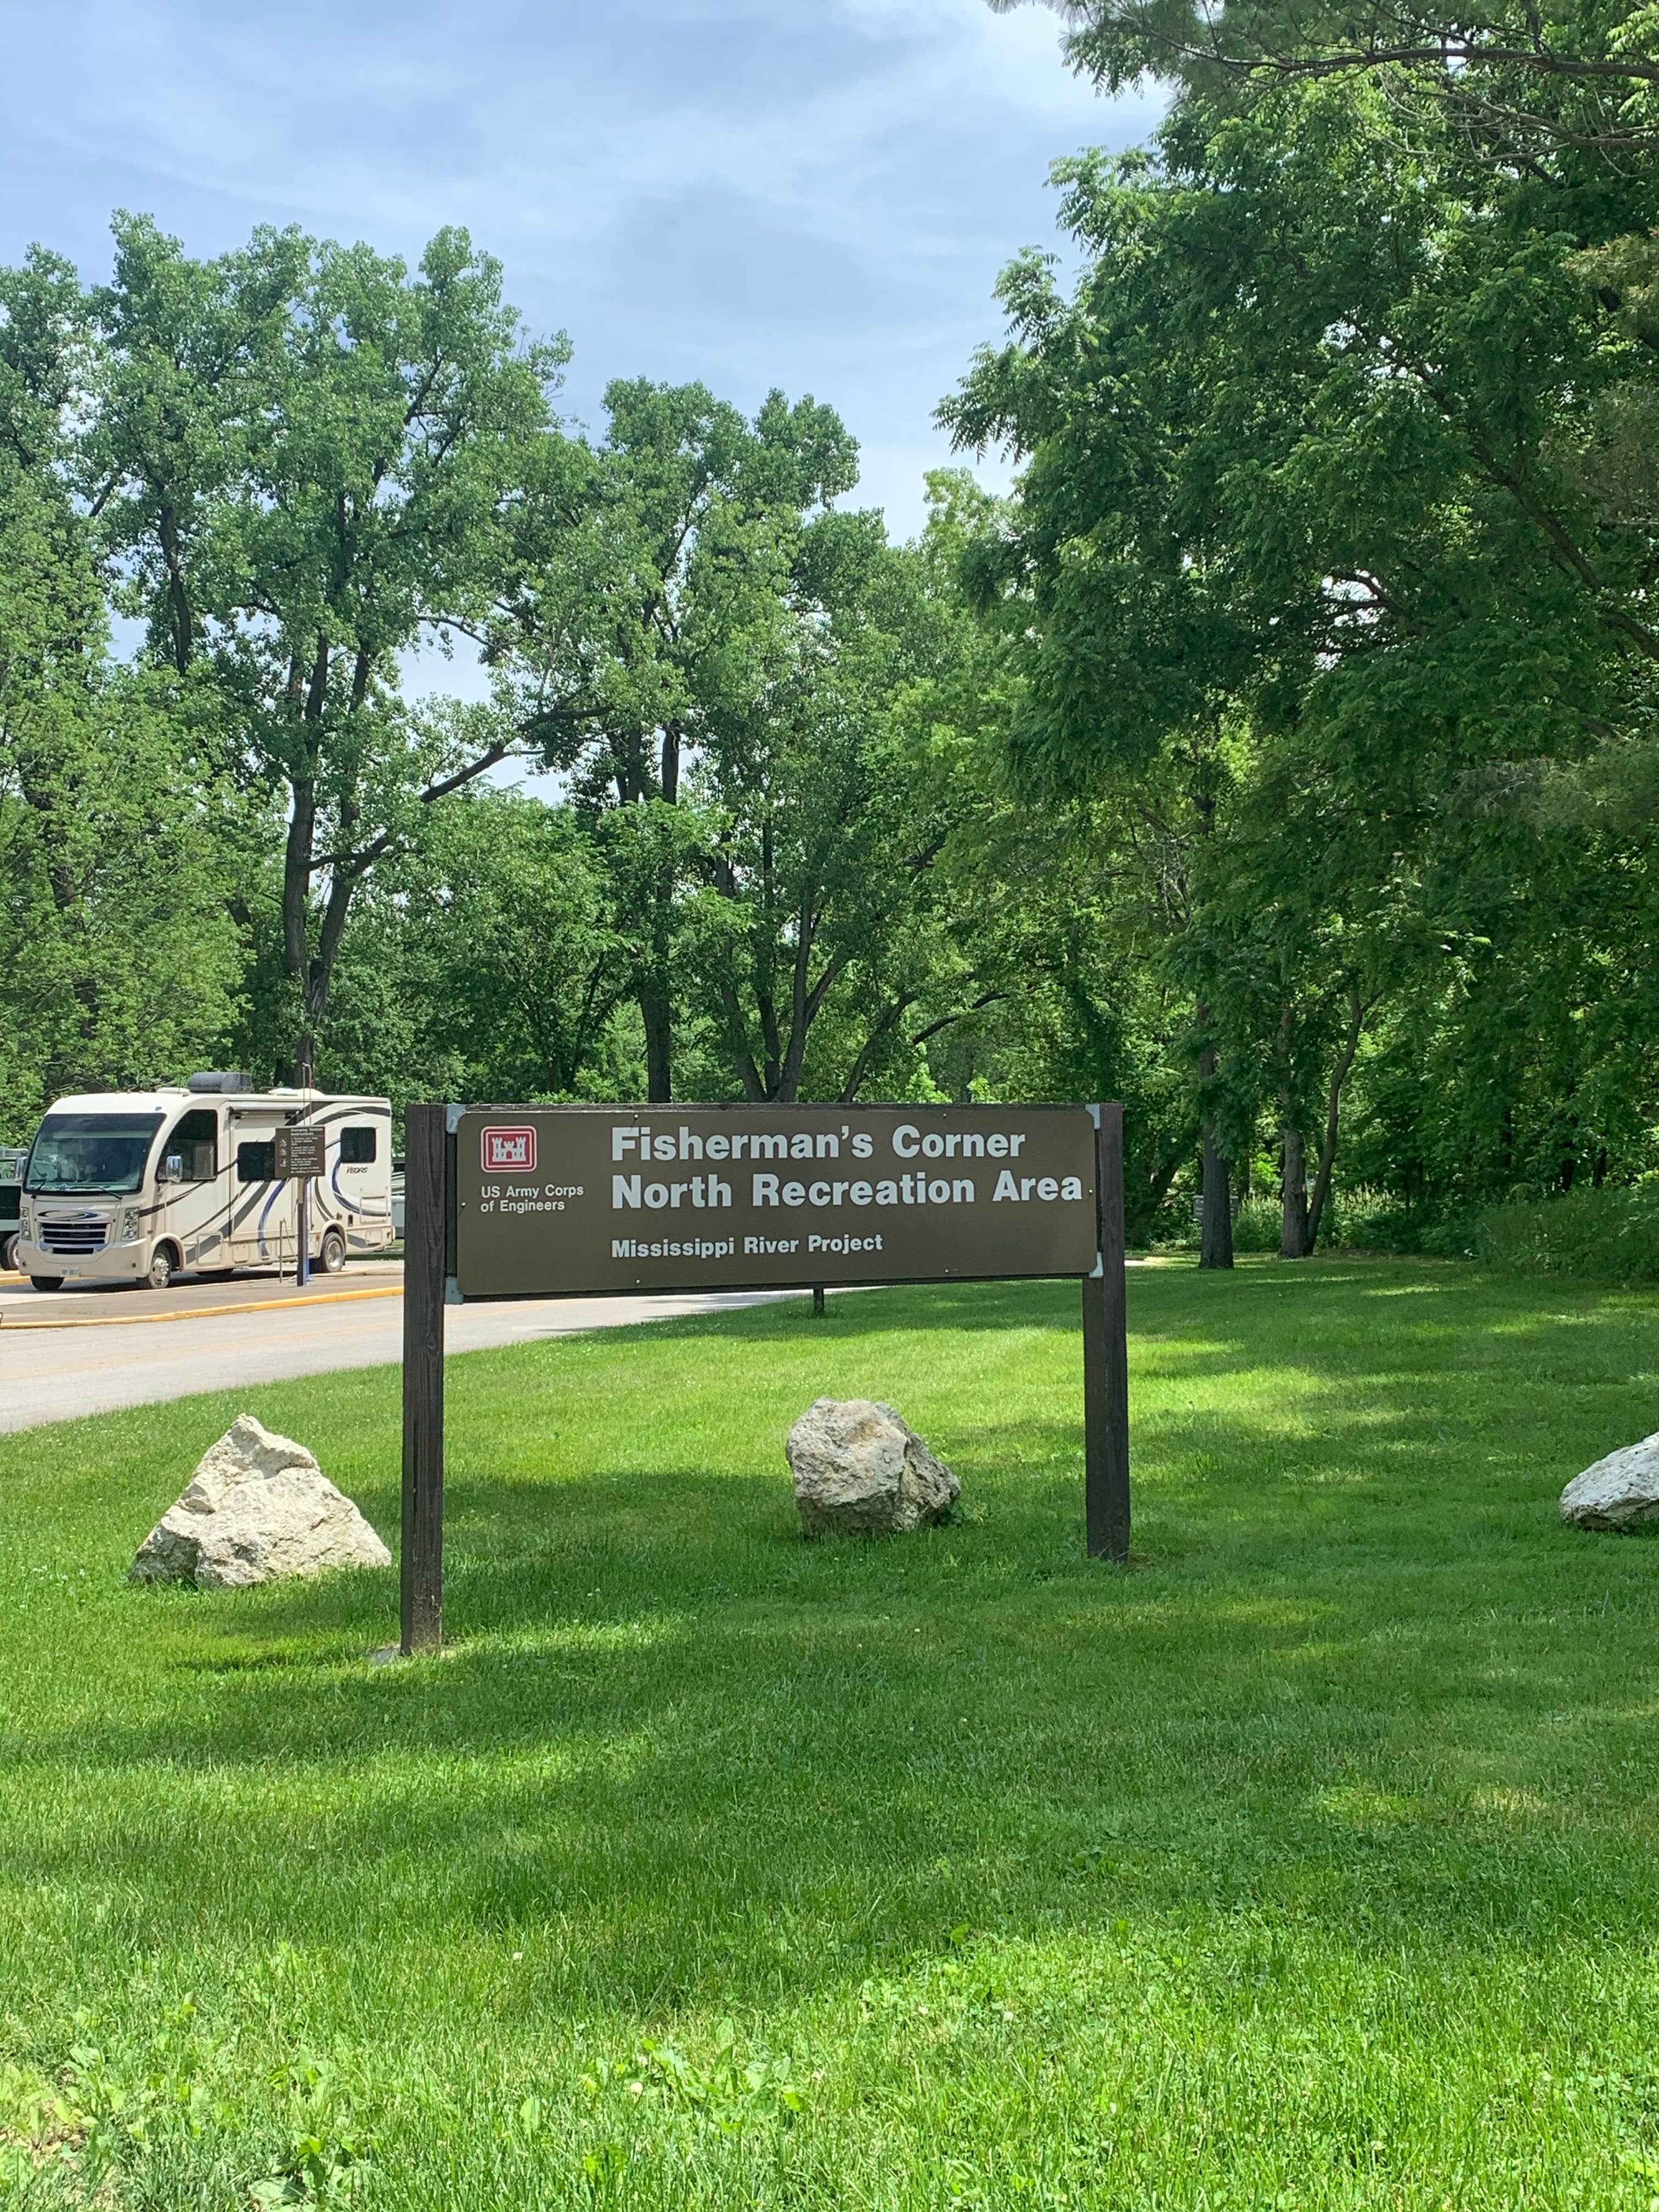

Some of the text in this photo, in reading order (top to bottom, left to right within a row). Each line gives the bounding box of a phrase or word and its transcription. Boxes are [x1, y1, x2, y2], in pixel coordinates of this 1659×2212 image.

[612, 1125, 1025, 1161] Fisherman's Corner
[481, 1184, 584, 1199] US Army Corps
[612, 1170, 1082, 1209] North Recreation Area
[480, 1199, 566, 1214] of Engineers
[612, 1234, 883, 1259] Mississippi River Project
